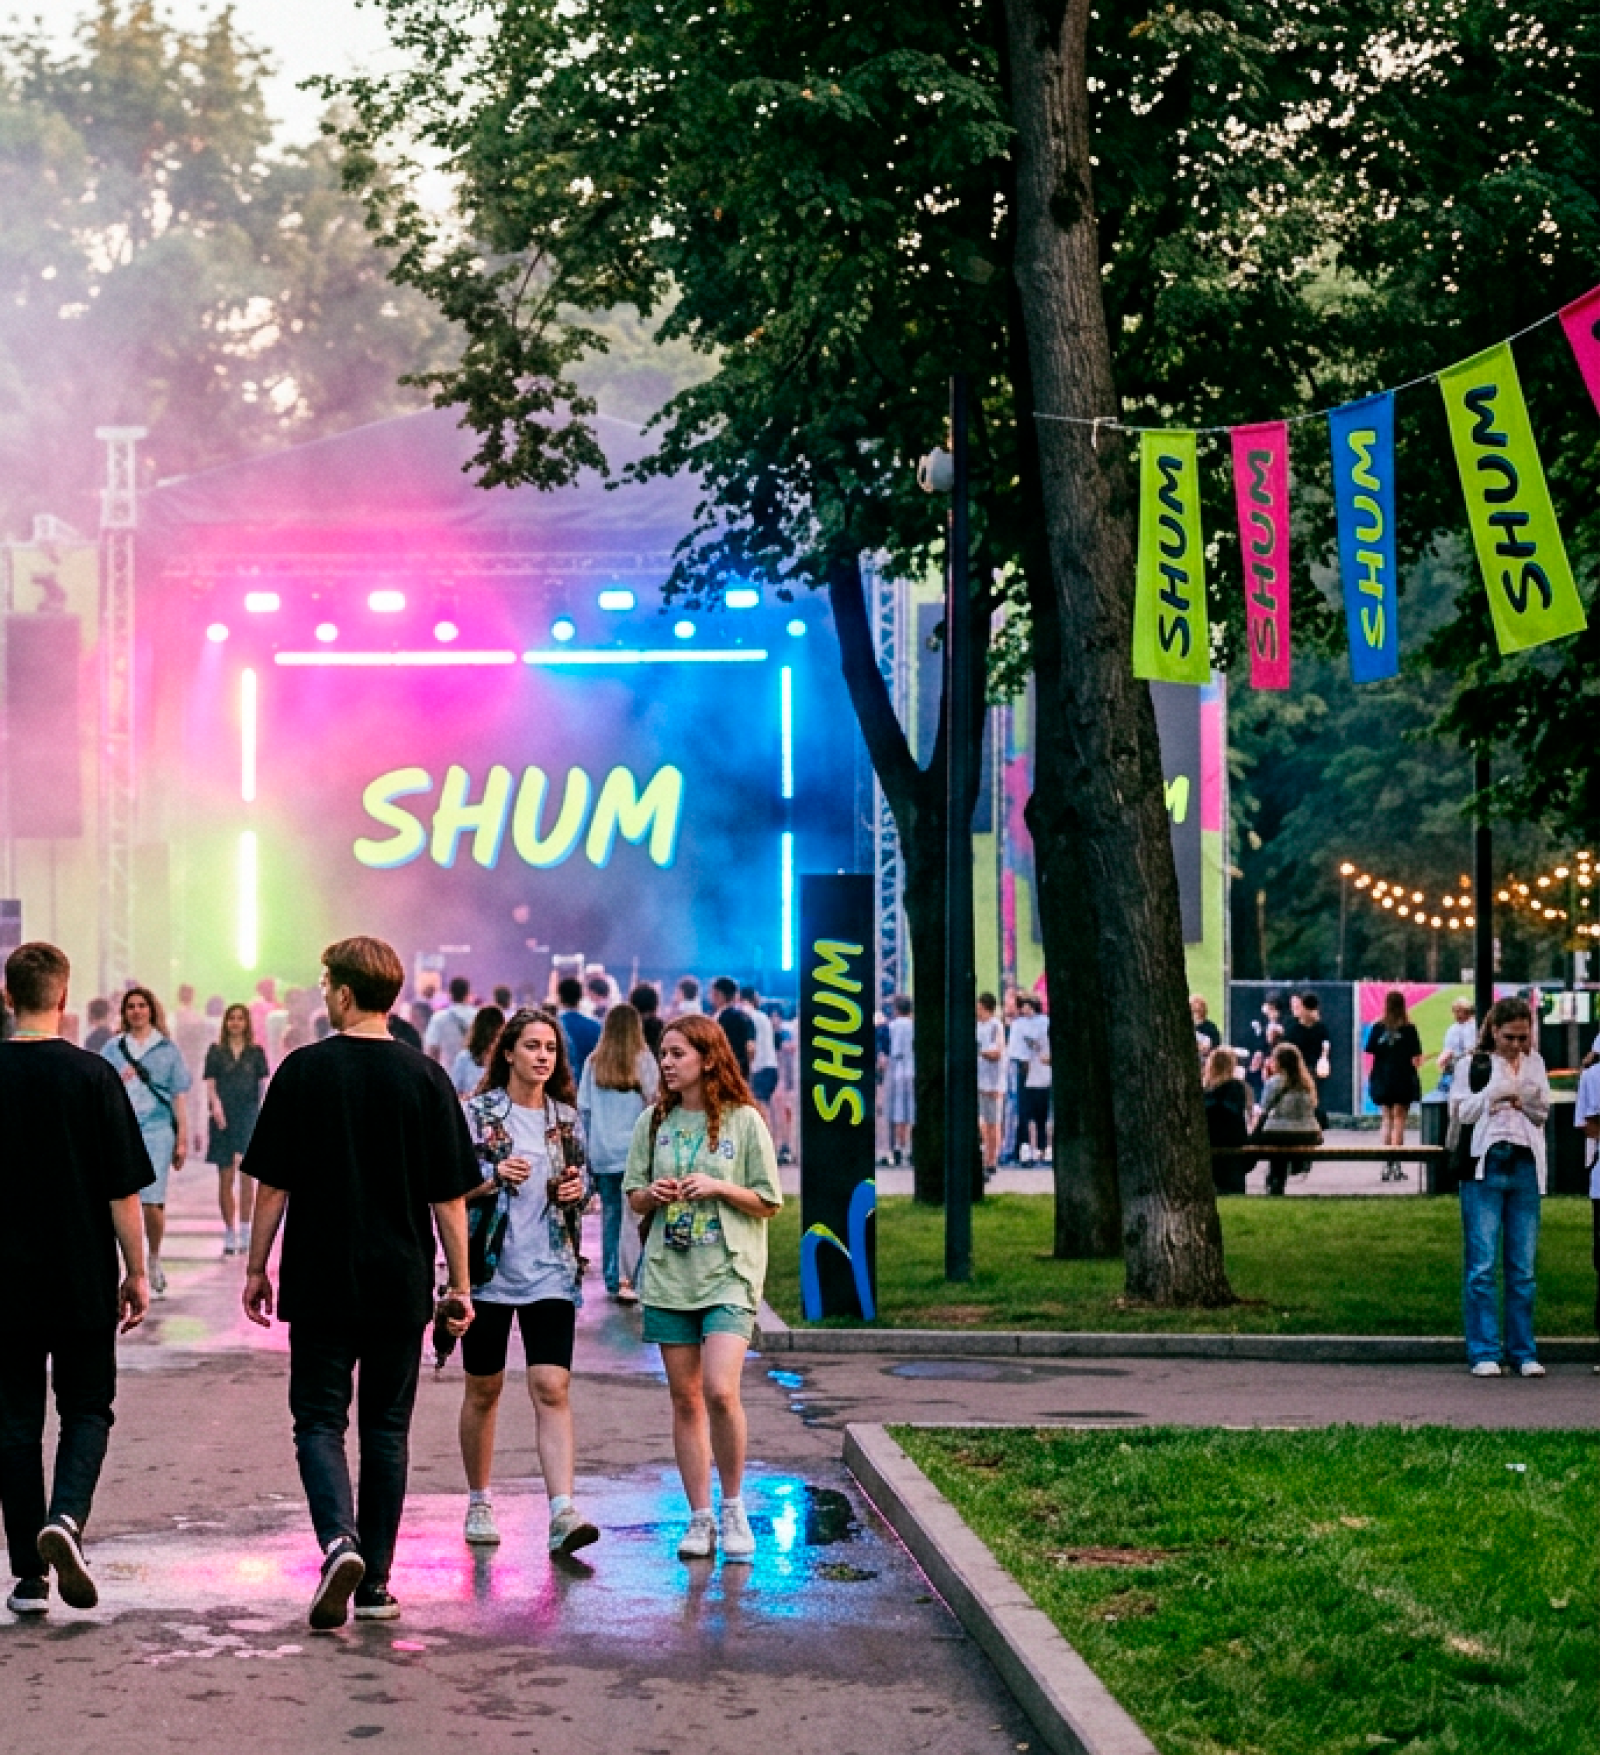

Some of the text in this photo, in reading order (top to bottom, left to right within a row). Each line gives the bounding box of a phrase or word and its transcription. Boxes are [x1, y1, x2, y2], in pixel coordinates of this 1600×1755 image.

[1157, 454, 1190, 659] SHUM
[1245, 449, 1278, 664] SHUM
[1347, 428, 1384, 650] SHUM
[1463, 383, 1553, 616] SHUM
[354, 764, 681, 868] SHUM
[812, 938, 863, 1126] SHUM
